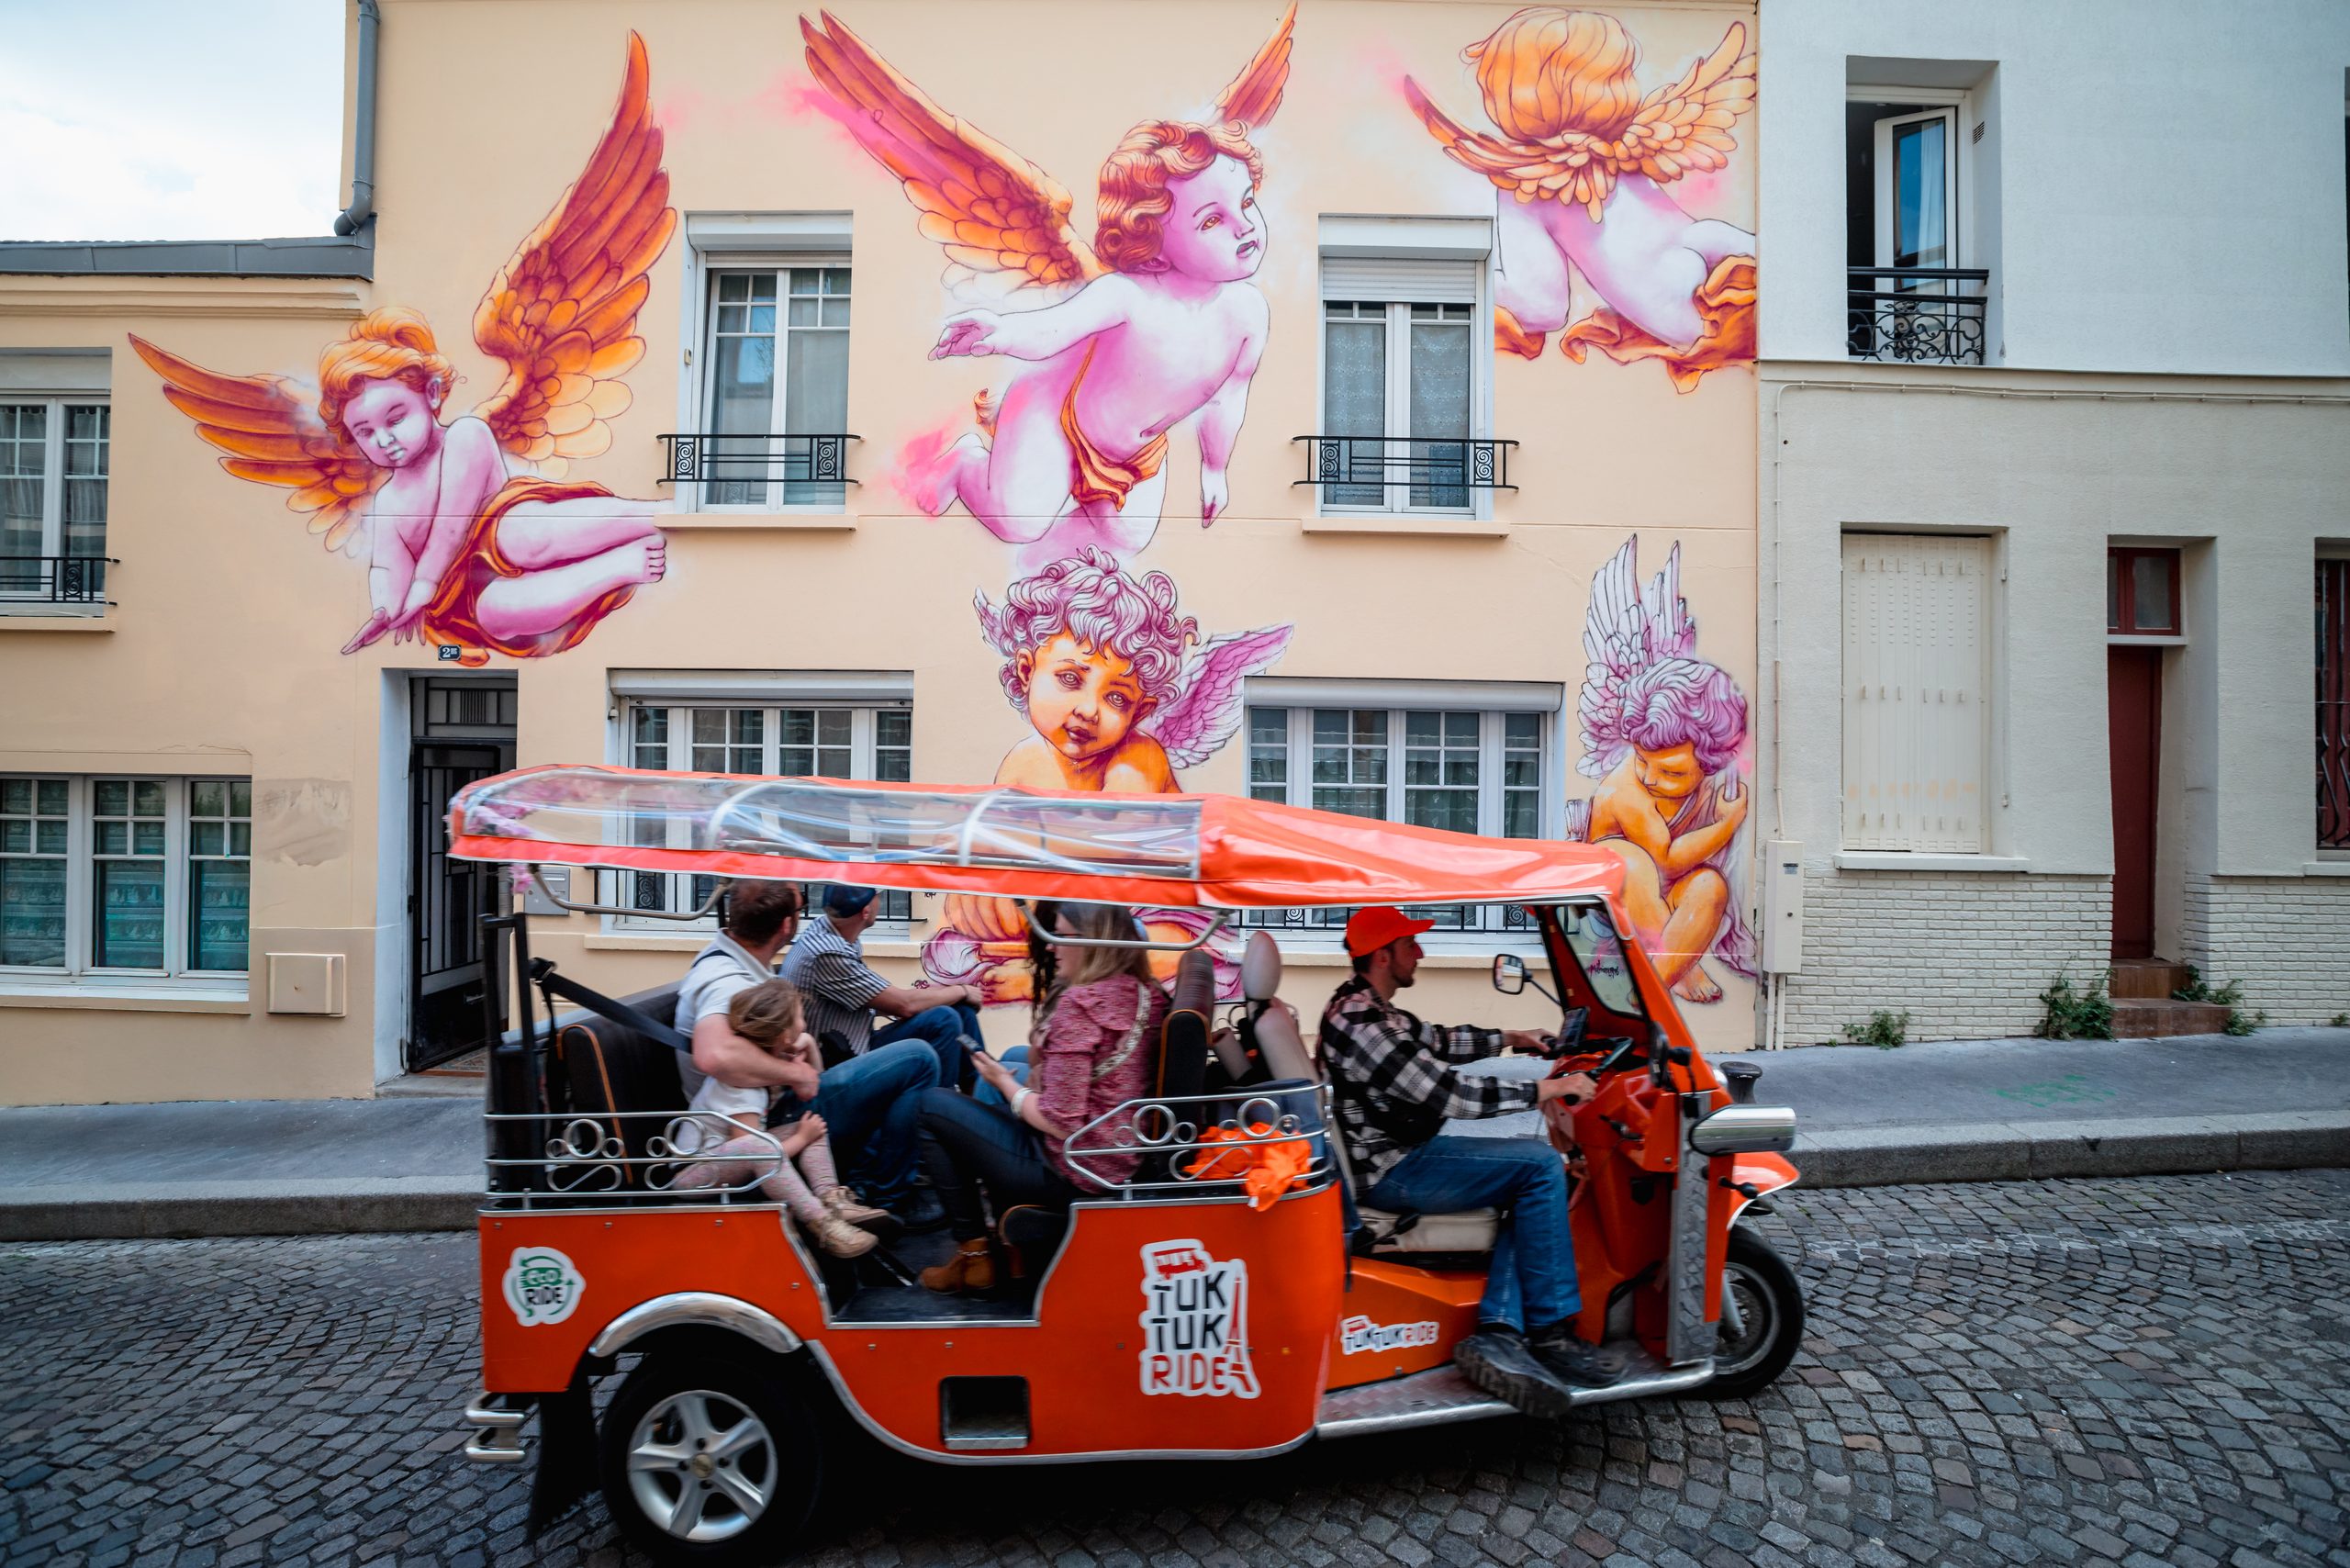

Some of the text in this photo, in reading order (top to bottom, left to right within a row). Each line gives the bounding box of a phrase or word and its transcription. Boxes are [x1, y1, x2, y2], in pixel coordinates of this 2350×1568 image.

[524, 1286, 563, 1305] RIDE
[1152, 1270, 1227, 1316] TUK
[1150, 1314, 1227, 1353] TUK
[1149, 1352, 1227, 1391] RIDE
